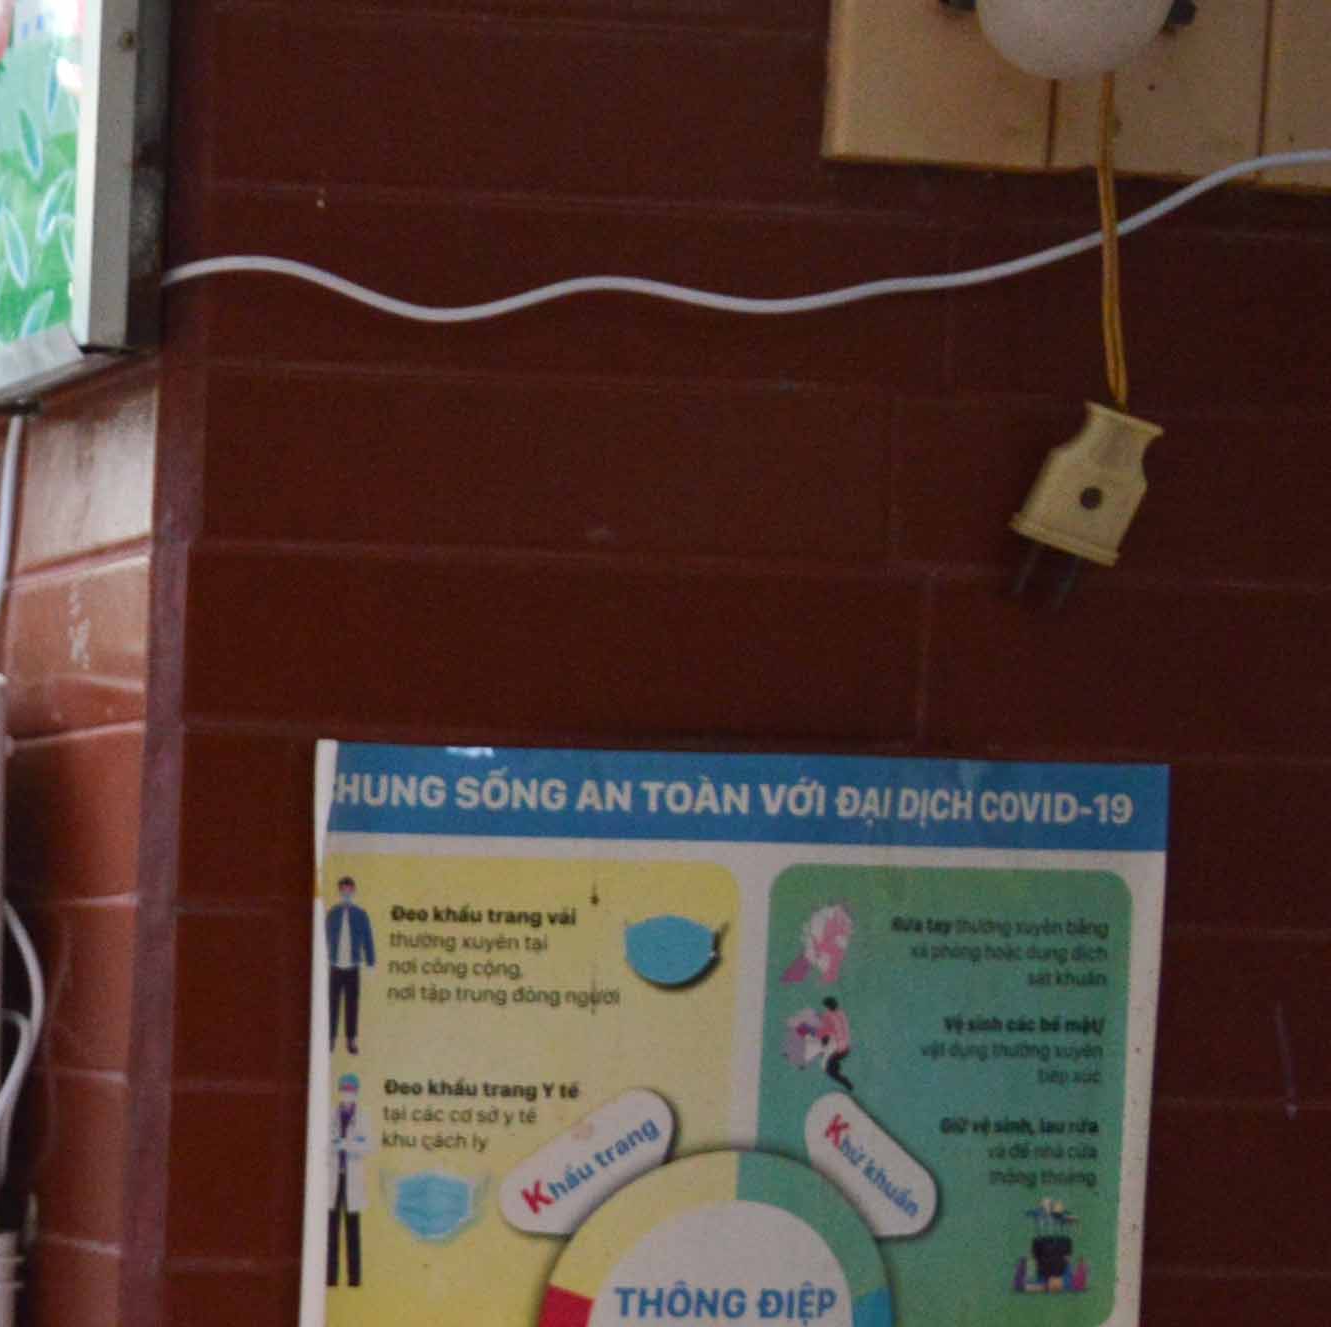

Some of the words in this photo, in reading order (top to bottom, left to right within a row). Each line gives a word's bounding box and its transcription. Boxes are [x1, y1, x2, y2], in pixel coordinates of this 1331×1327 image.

[455, 766, 566, 812] SỐNG
[576, 777, 633, 812] AN
[638, 778, 750, 816] TOÀN
[760, 776, 825, 817] VỚI
[836, 784, 891, 828] ĐẠI
[897, 787, 973, 829] DỊCH
[980, 792, 1133, 825] COVID-19
[390, 905, 429, 923] Đeo
[488, 907, 542, 928] trang
[462, 932, 520, 953] xuyên
[524, 934, 548, 954] tại
[388, 959, 417, 976] nơi
[421, 959, 468, 978] công
[387, 985, 415, 1001] nơi
[456, 986, 507, 1006] trung
[384, 1079, 423, 1097] Đeo
[482, 1081, 538, 1102] trang
[542, 1082, 556, 1098] Y
[382, 1106, 408, 1123] tại
[411, 1105, 444, 1123] các
[503, 1110, 516, 1128] y
[381, 1130, 417, 1149] khu
[421, 1130, 468, 1152] cách
[594, 1118, 661, 1169] trang
[614, 1280, 748, 1319] THÔNG
[757, 1280, 838, 1327] ĐIỆP
